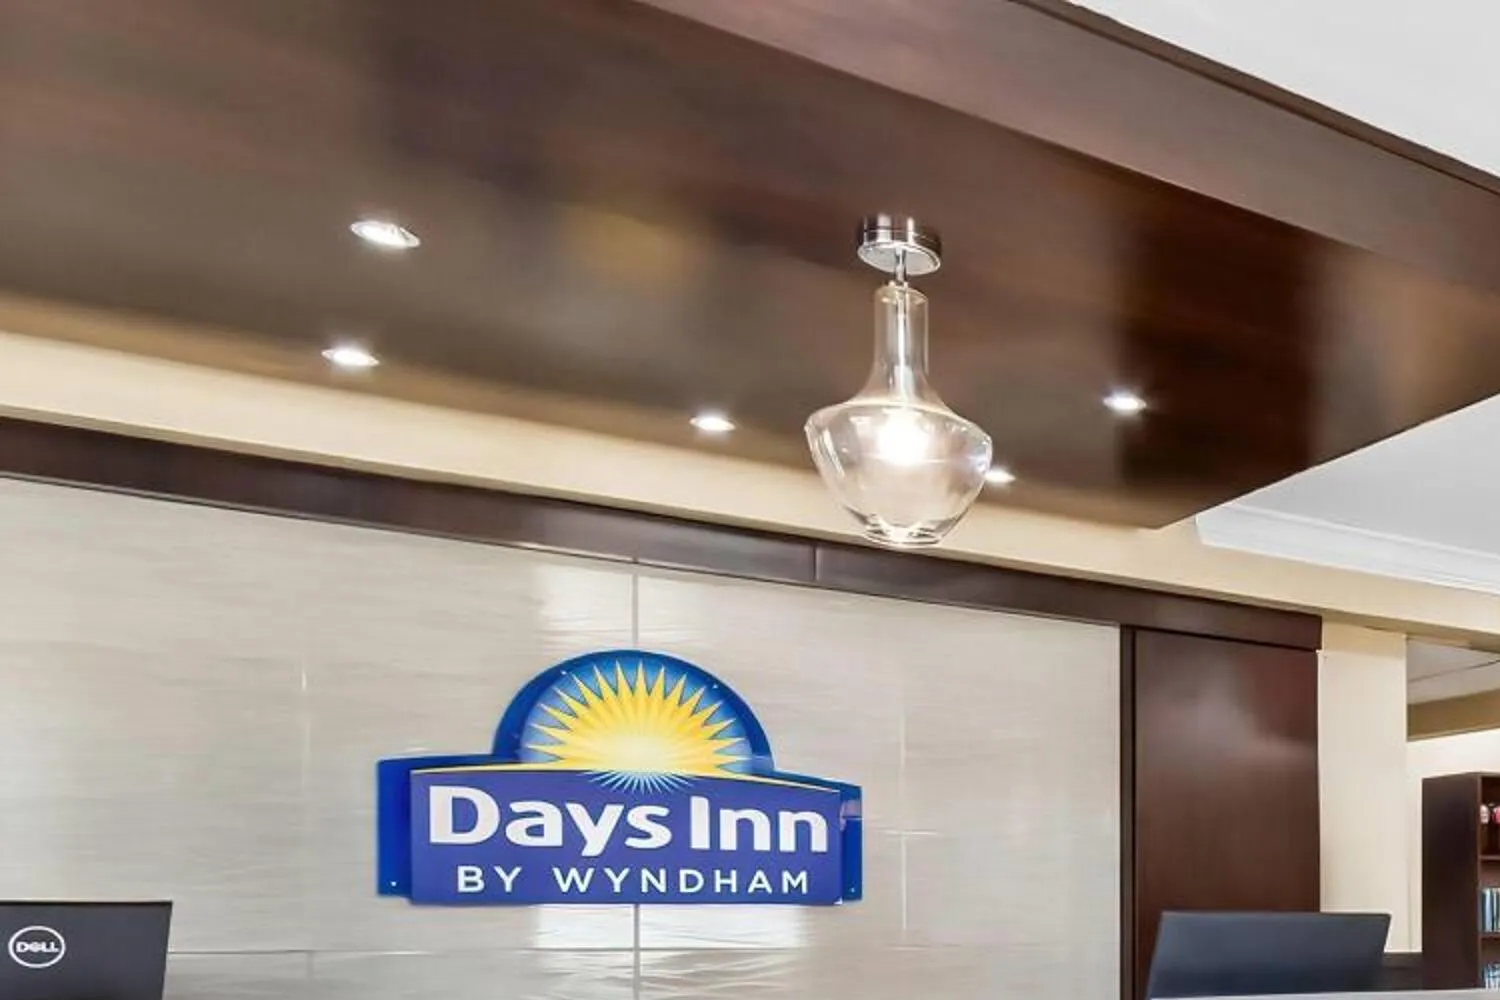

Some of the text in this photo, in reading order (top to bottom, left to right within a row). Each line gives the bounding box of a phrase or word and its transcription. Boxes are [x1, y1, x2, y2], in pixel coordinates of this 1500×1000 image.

[429, 785, 829, 857] Days Inn
[457, 865, 808, 894] BY WYNDHAM
[15, 941, 60, 953] DELL
